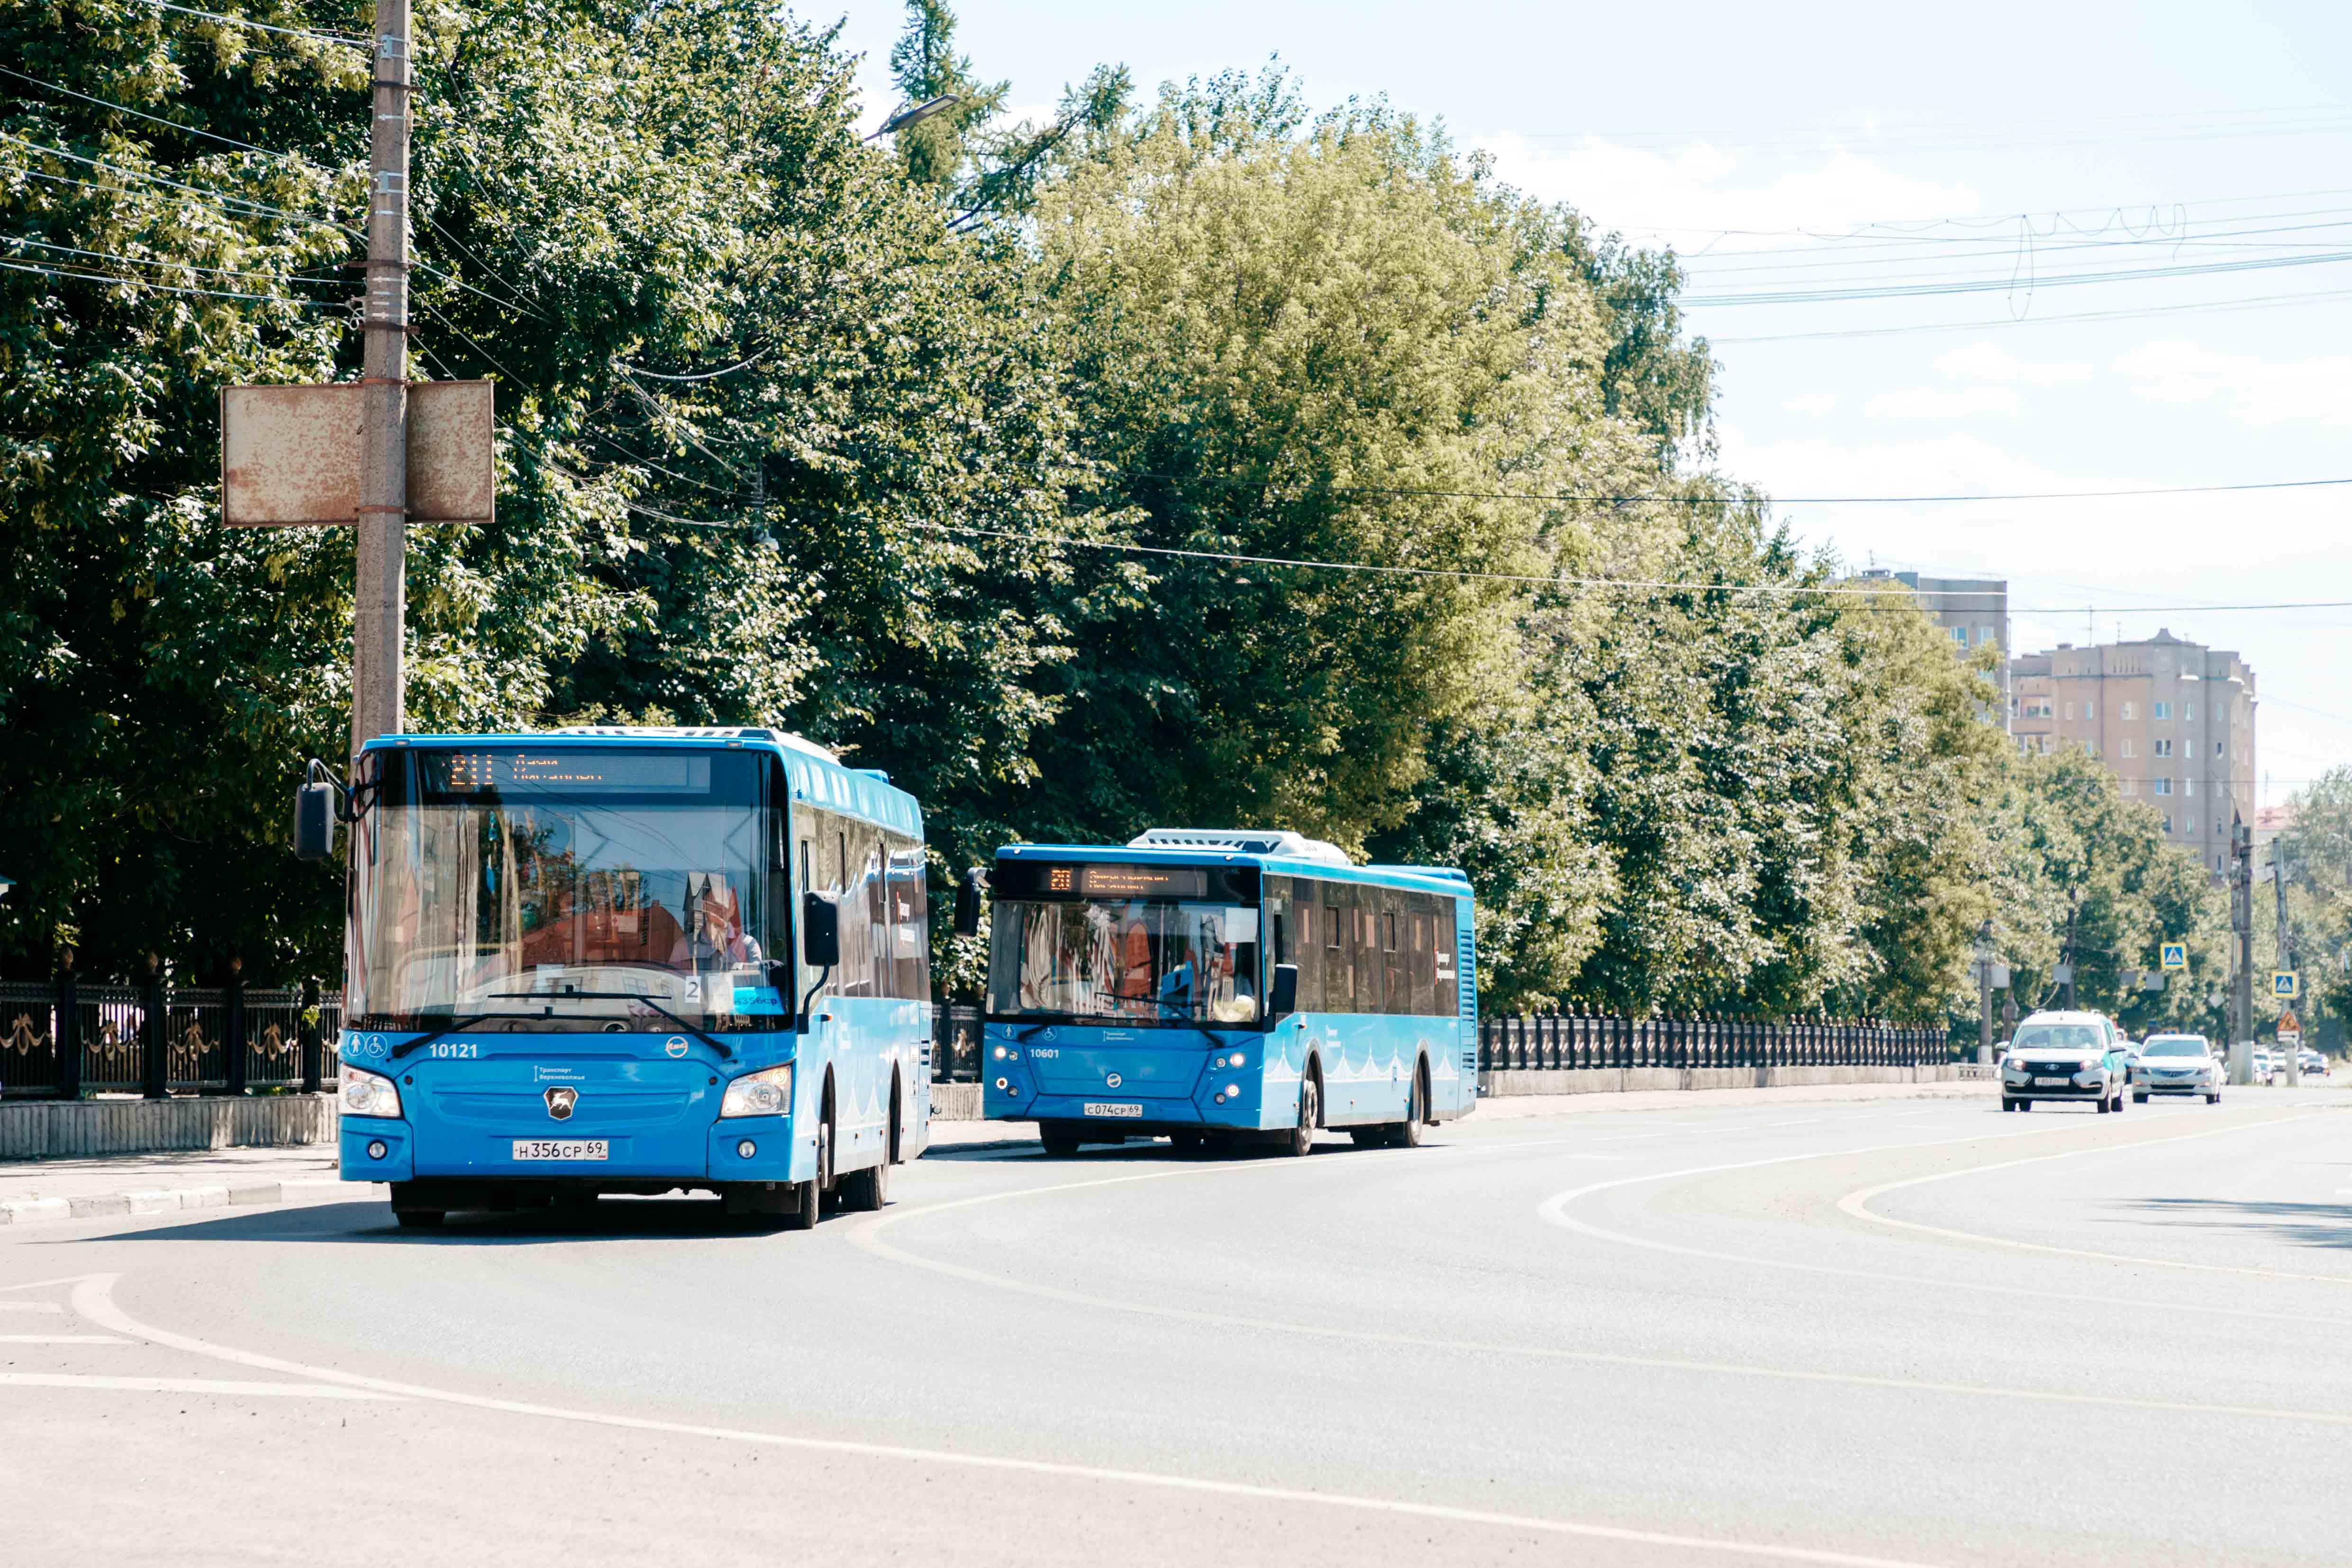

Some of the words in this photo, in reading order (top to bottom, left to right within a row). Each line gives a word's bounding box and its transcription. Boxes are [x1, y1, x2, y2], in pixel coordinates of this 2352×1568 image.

[452, 754, 493, 785] 211
[686, 981, 699, 998] 2
[429, 1043, 477, 1058] 10121
[1030, 1049, 1059, 1058] 10601
[587, 1142, 602, 1154] 69
